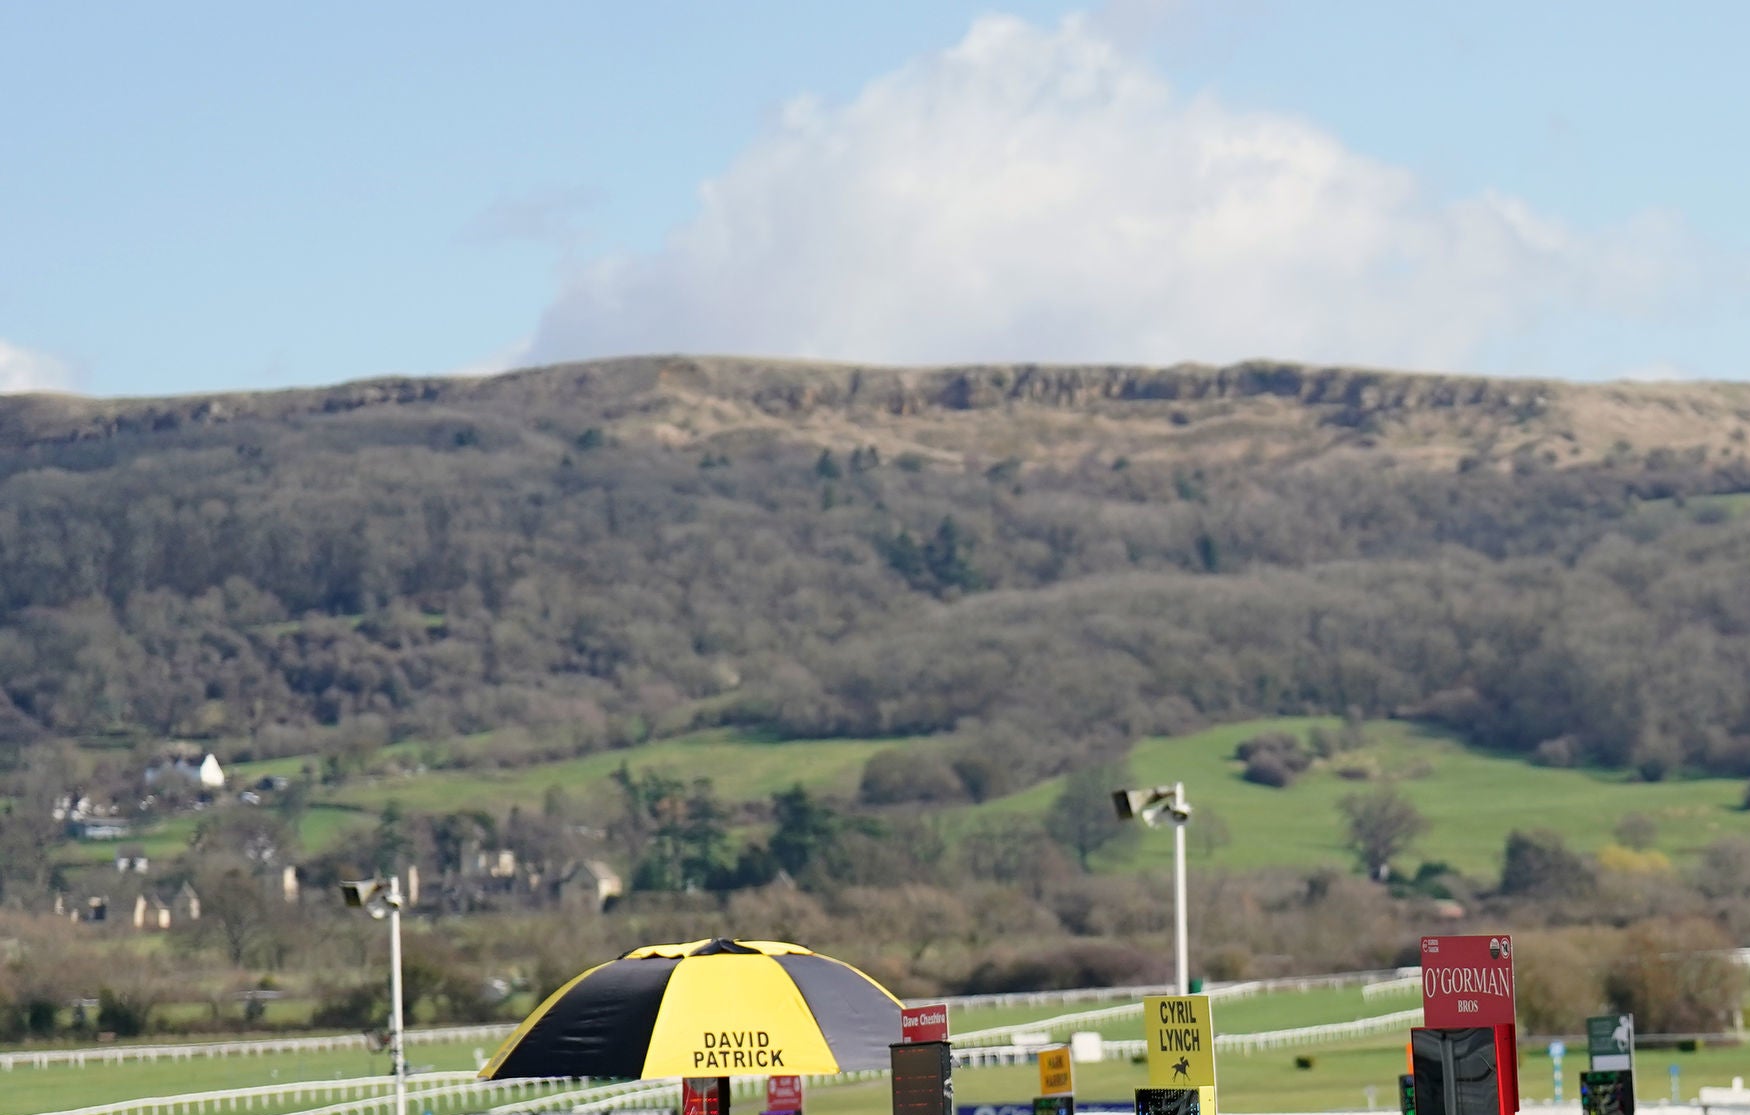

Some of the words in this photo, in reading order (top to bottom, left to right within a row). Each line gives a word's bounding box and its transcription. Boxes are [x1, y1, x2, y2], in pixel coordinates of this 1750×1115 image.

[1160, 1001, 1197, 1024] CYRIL
[1458, 1000, 1478, 1013] BROS
[903, 1016, 918, 1027] Dave
[920, 1013, 945, 1025] Cheshire
[704, 1031, 769, 1048] DAVID
[1160, 1028, 1200, 1051] LYNCH
[694, 1049, 784, 1068] PATRICK
